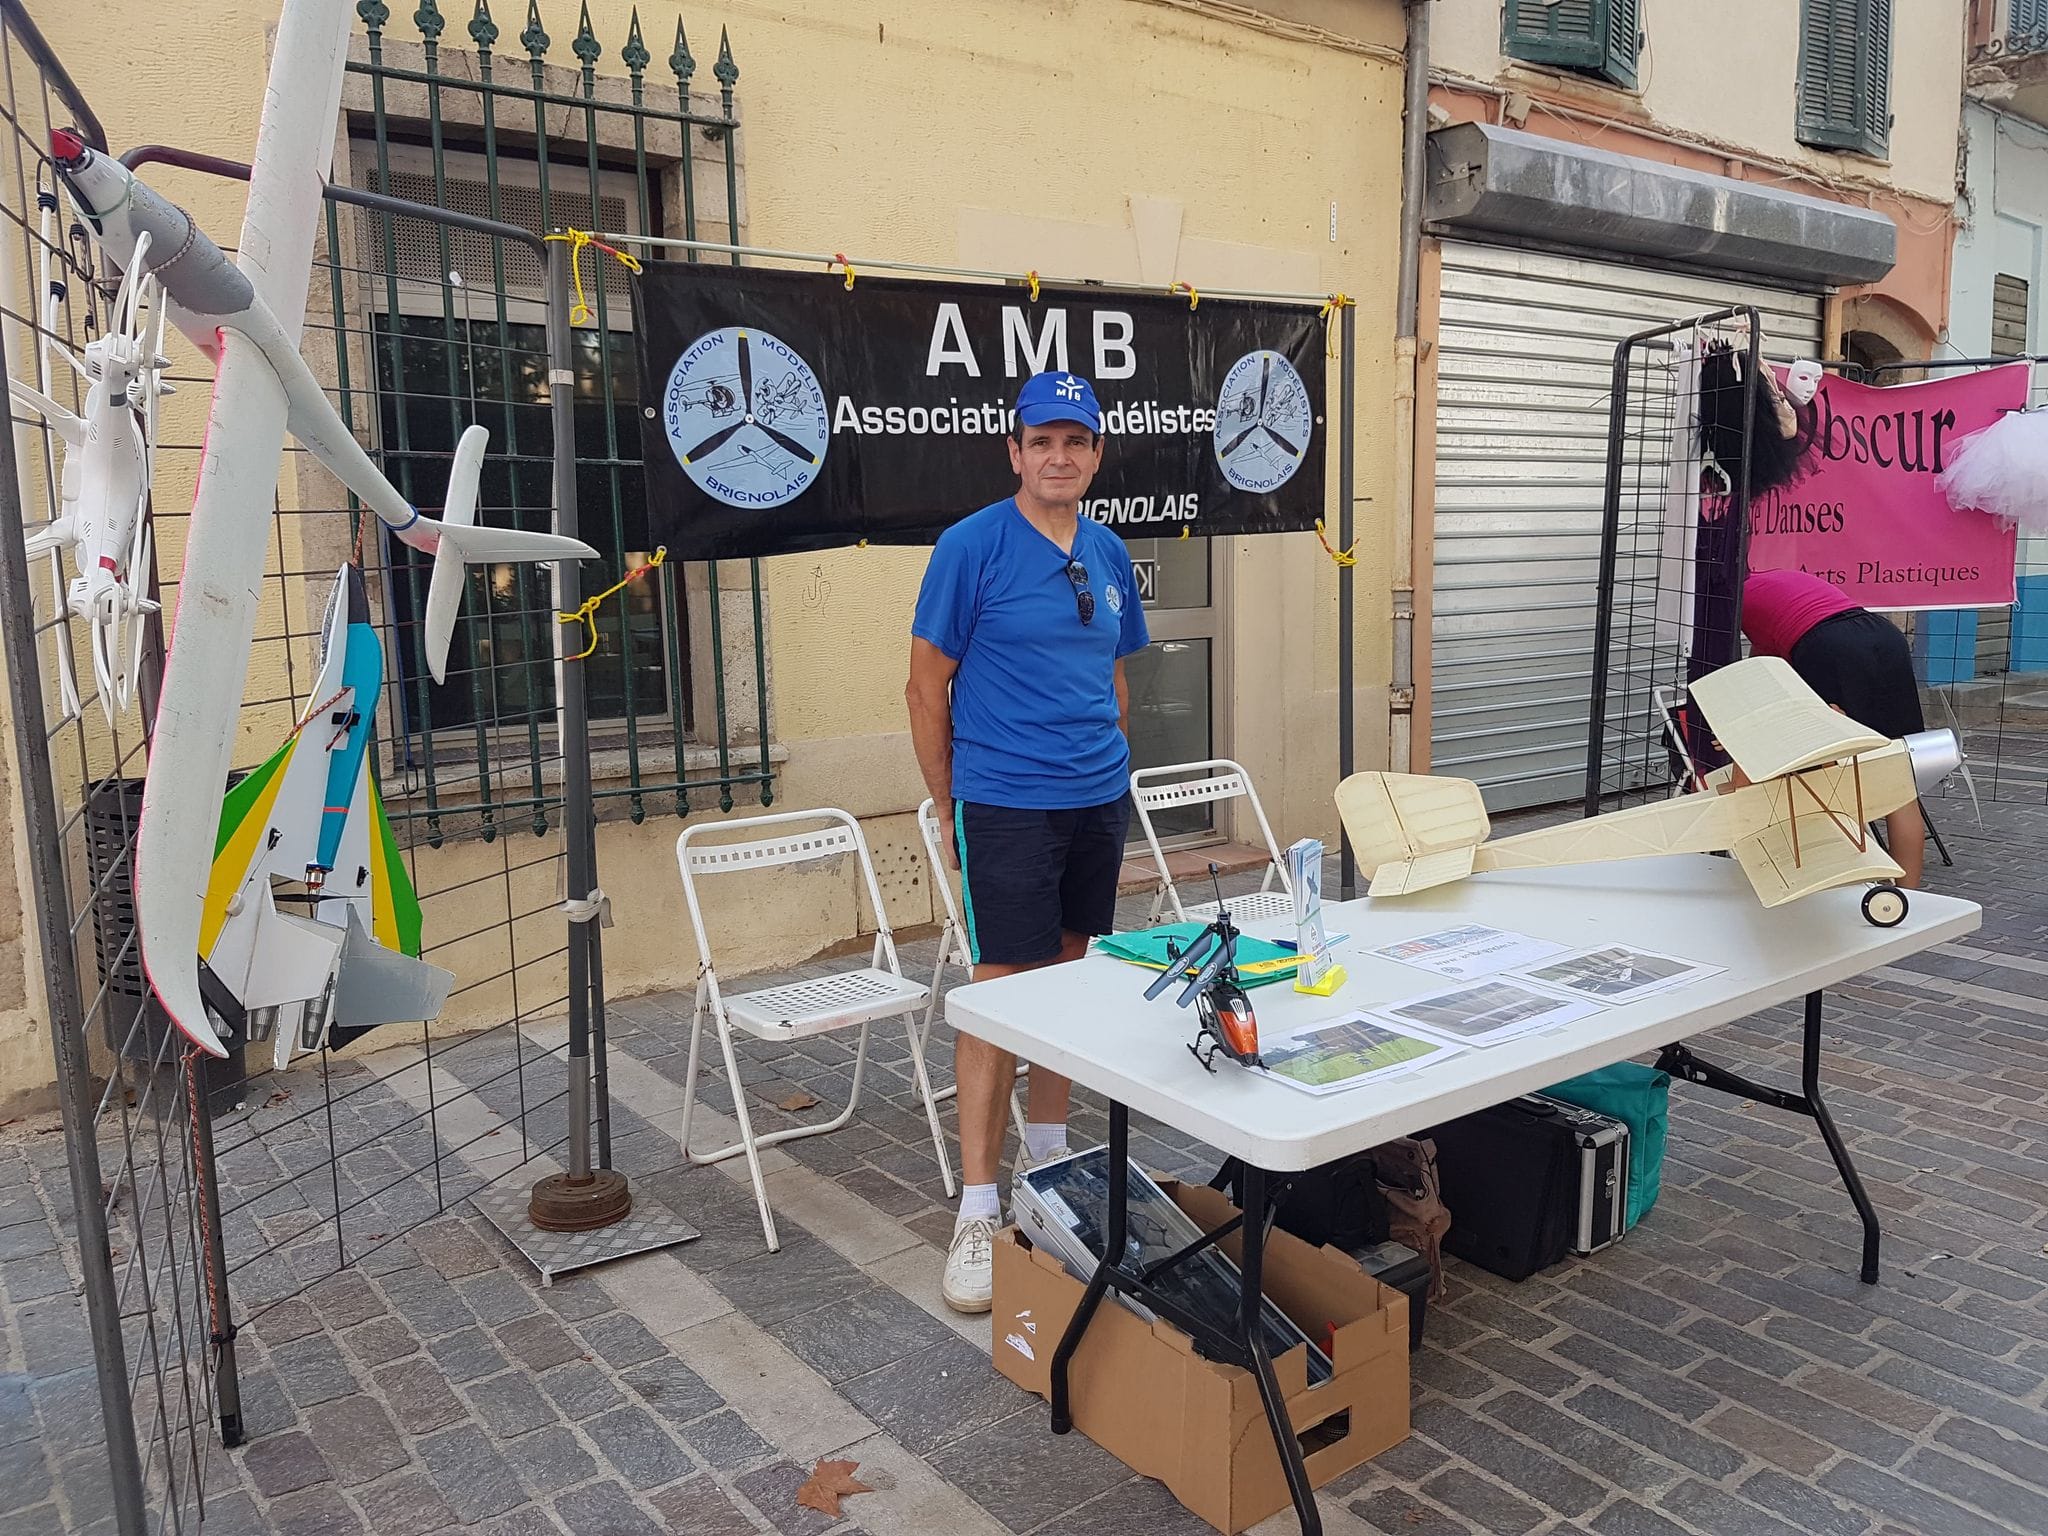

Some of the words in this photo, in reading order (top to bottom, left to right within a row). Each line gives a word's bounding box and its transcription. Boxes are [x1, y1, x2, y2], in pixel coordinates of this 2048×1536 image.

[668, 334, 725, 439] ASSOCIATION
[761, 337, 826, 440] MODÉLISTES
[1216, 356, 1256, 439] ASSOCIATION
[833, 395, 1015, 435] Associati
[1098, 400, 1216, 435] délistes
[705, 471, 809, 503] BRIGNOLAIS
[1228, 463, 1293, 489] BRIGNOLAIS
[1078, 493, 1199, 525] IGNOLAIS
[1765, 486, 1844, 535] Danses
[1856, 560, 1980, 587] Plastiques
